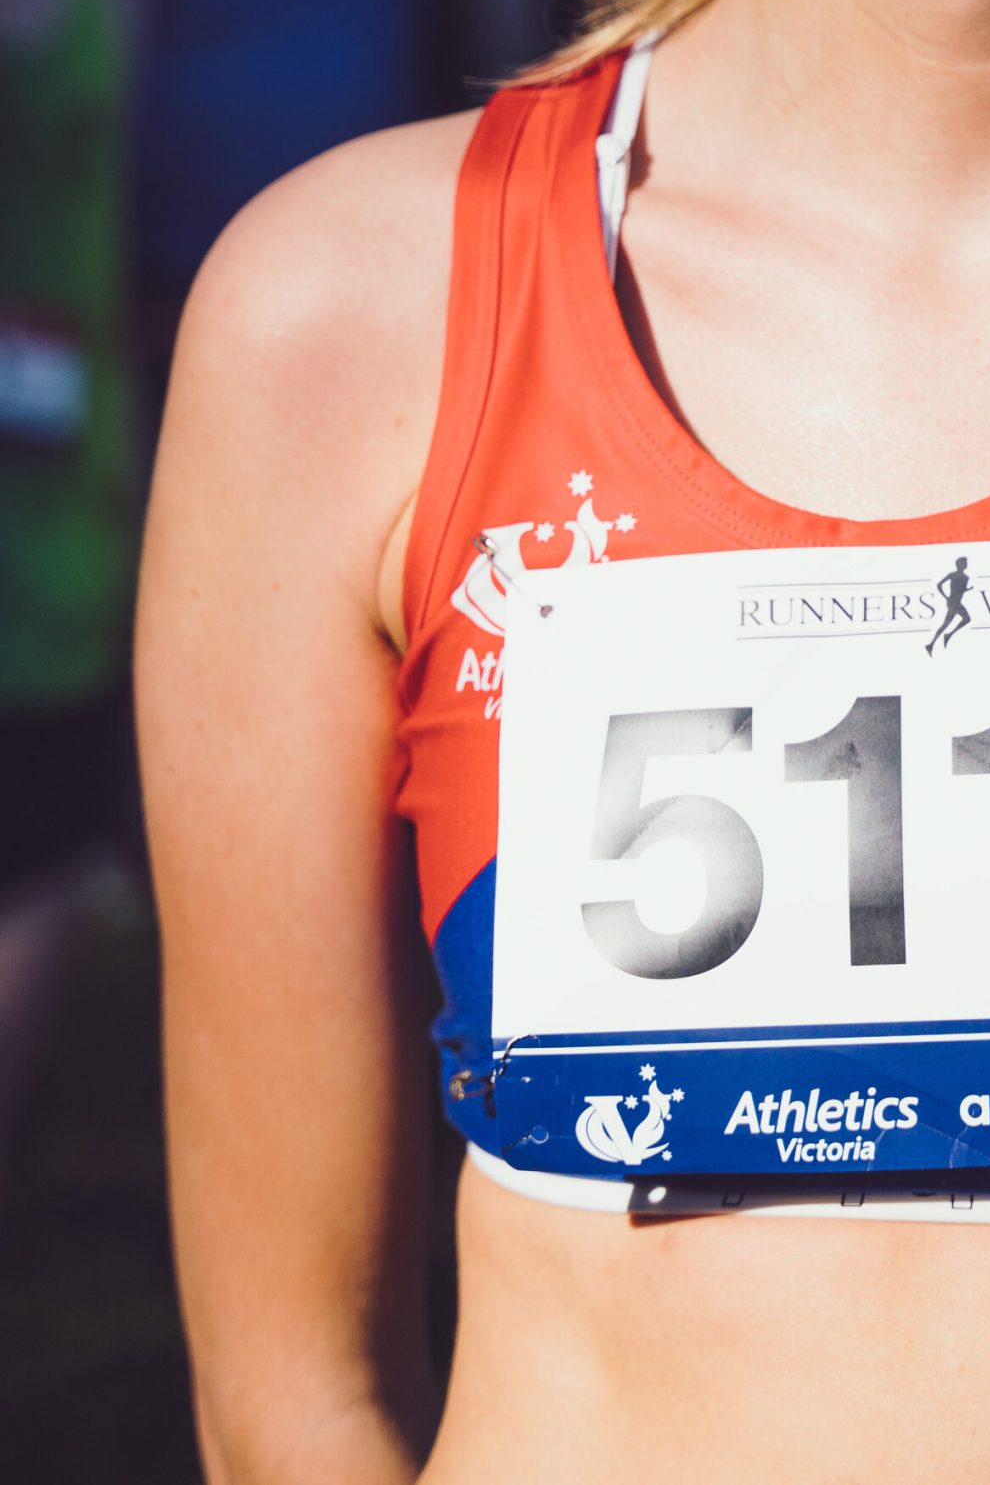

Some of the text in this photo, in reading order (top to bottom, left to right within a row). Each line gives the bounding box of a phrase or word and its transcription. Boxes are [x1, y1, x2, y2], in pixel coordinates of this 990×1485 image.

[738, 591, 935, 627] RUNNERS
[724, 1087, 919, 1135] Athletics
[776, 1135, 876, 1163] Victoria
